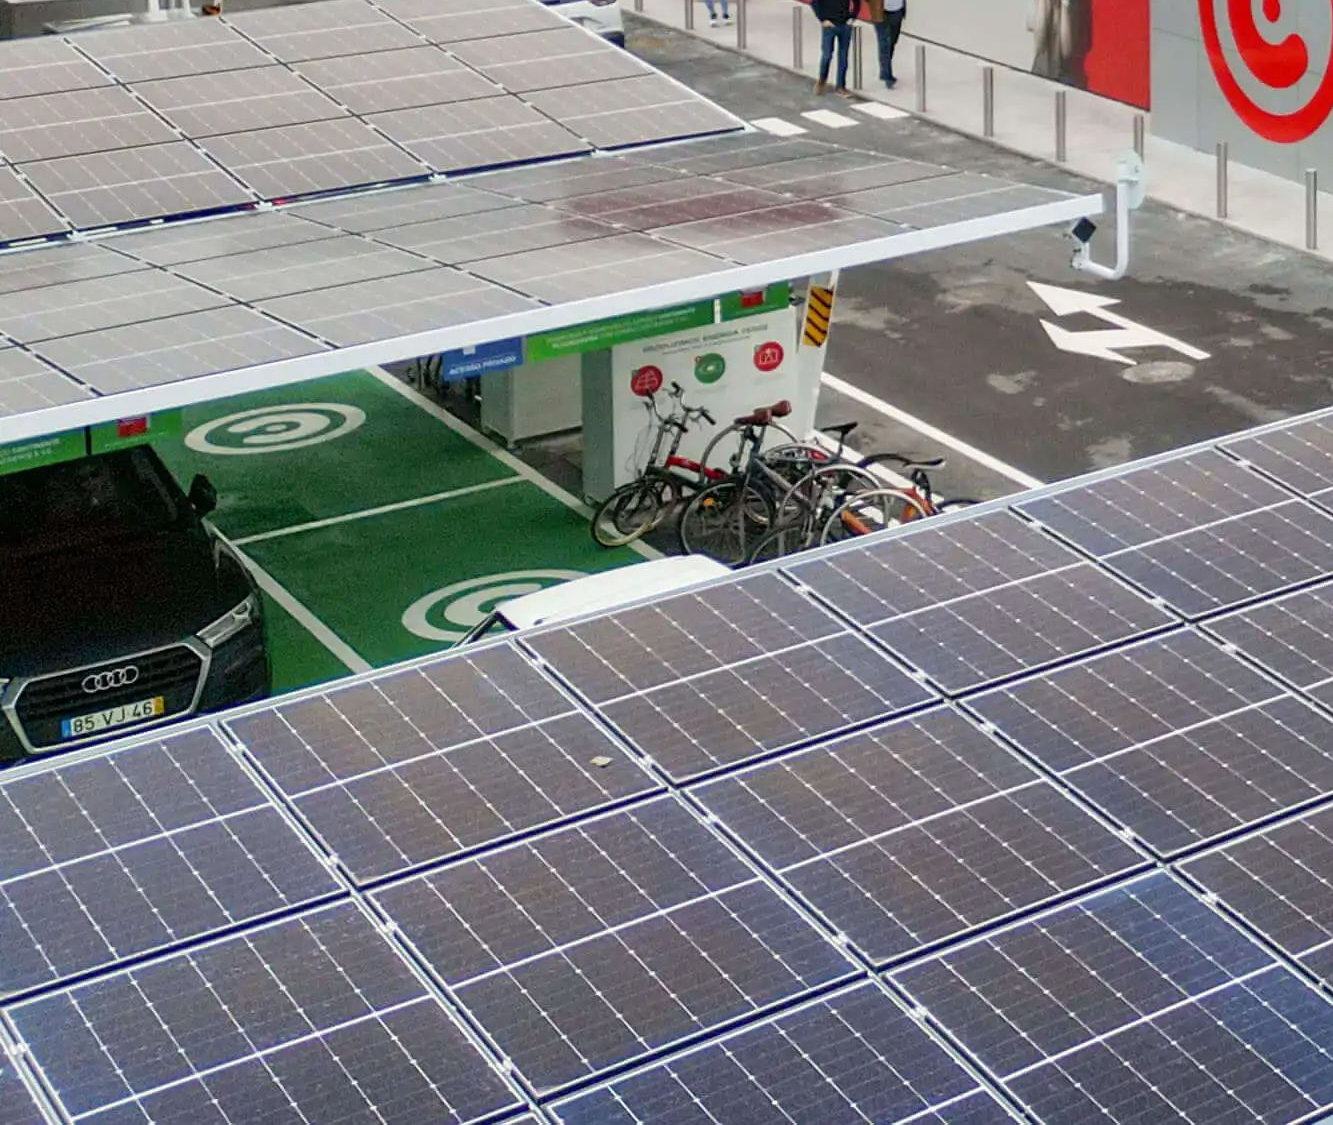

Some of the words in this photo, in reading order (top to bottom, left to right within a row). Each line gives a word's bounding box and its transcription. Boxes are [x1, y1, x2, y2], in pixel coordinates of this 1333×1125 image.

[73, 716, 95, 733] 85
[102, 709, 126, 726] VJ
[132, 701, 153, 718] 46
